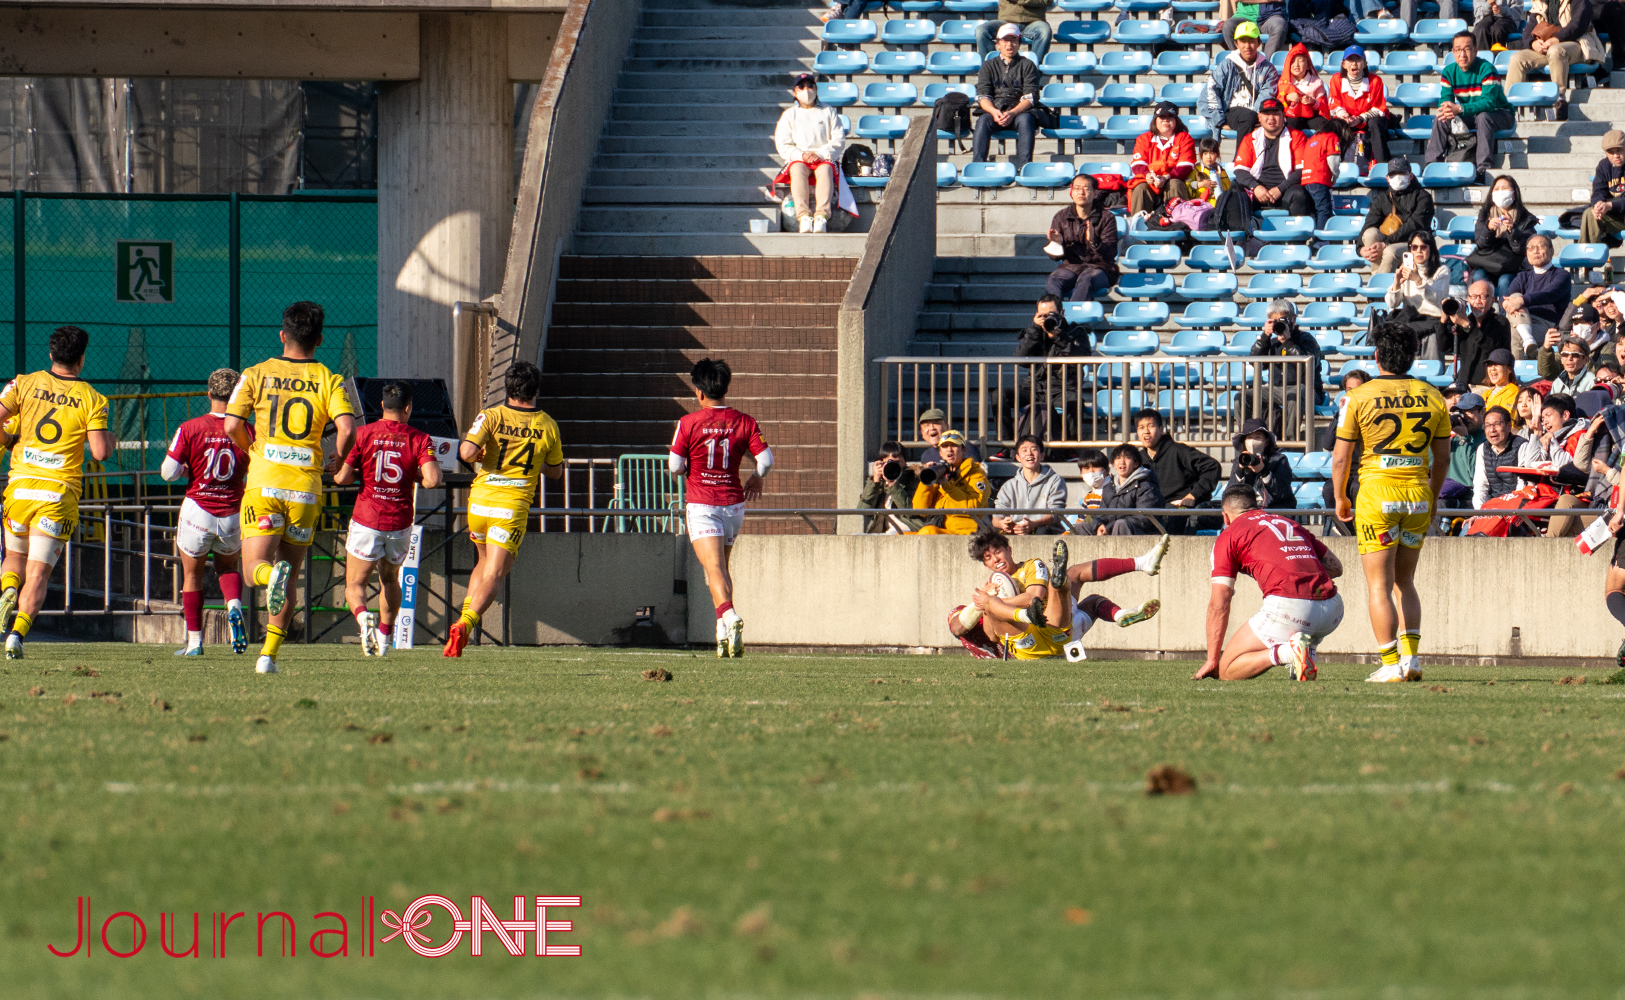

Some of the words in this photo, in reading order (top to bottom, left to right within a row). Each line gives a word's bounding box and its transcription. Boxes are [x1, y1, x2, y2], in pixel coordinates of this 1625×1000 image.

[33, 387, 82, 409] IMON
[262, 376, 321, 394] IMON
[267, 394, 314, 440] 10
[1373, 395, 1429, 409] IMON
[35, 407, 62, 444] 6
[498, 424, 544, 440] IMON
[1373, 411, 1432, 454] 23
[203, 447, 236, 482] 10
[372, 449, 404, 483] 15
[496, 438, 536, 476] 14
[704, 438, 730, 470] 11
[1258, 518, 1305, 542] 12
[405, 586, 413, 602] NTT
